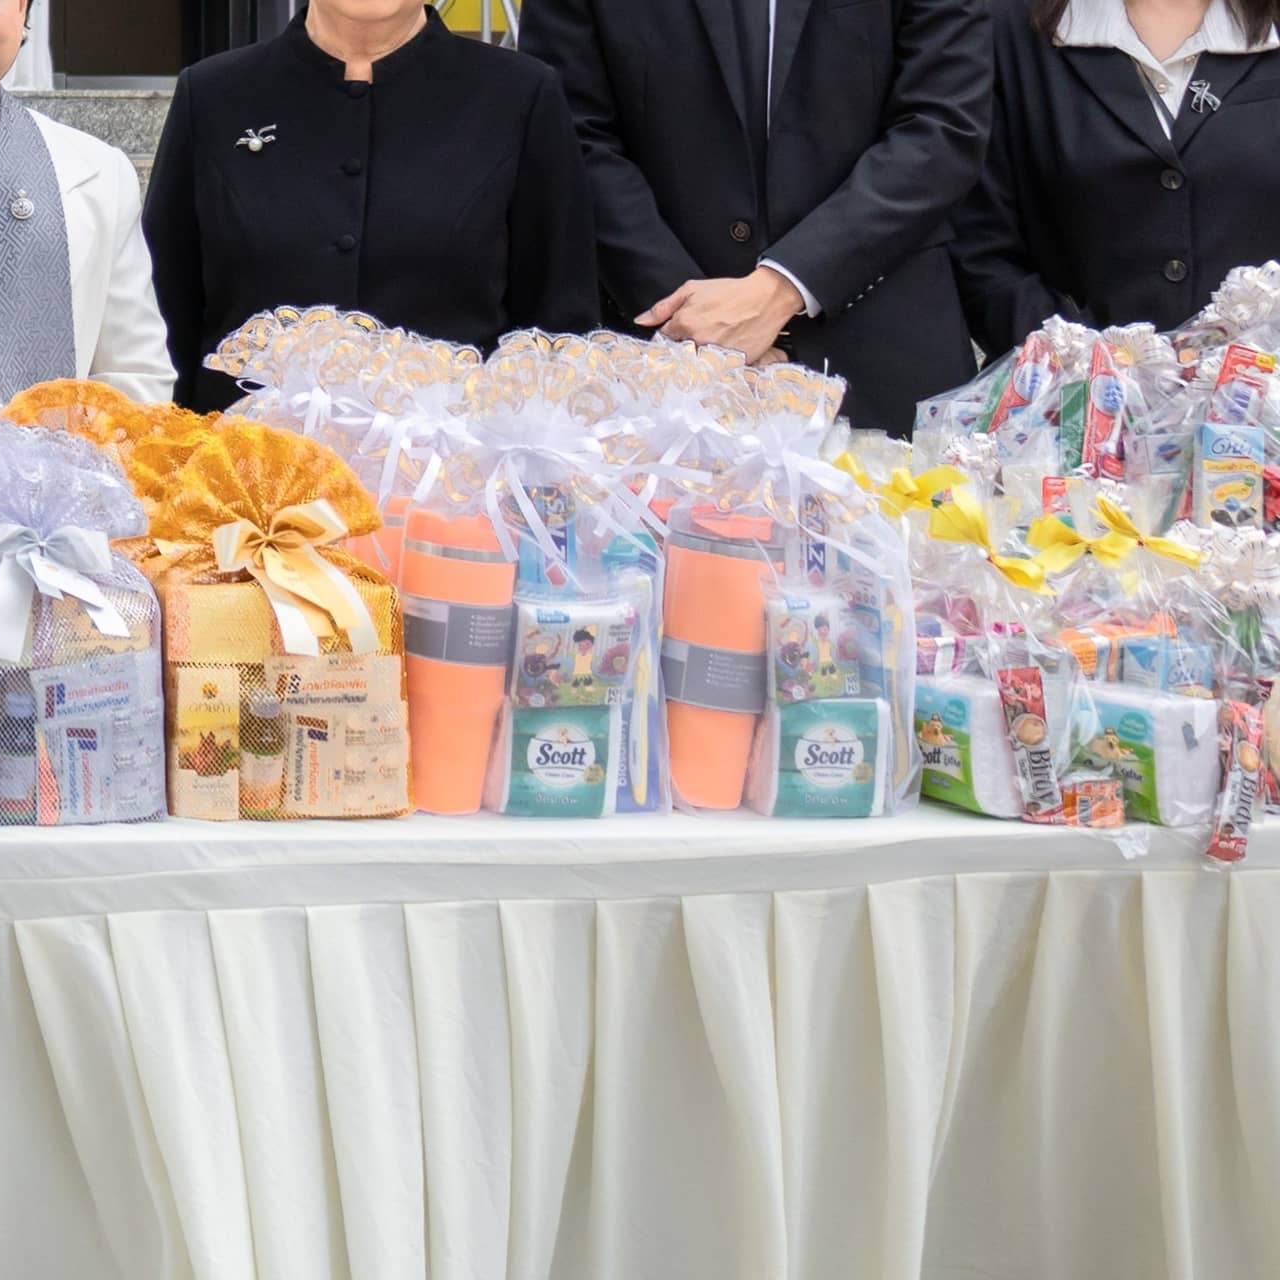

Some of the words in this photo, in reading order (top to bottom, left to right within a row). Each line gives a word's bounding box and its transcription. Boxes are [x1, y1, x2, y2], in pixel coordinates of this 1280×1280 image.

[535, 743, 587, 766] Scott
[803, 743, 856, 766] Scott
[920, 745, 942, 765] ott
